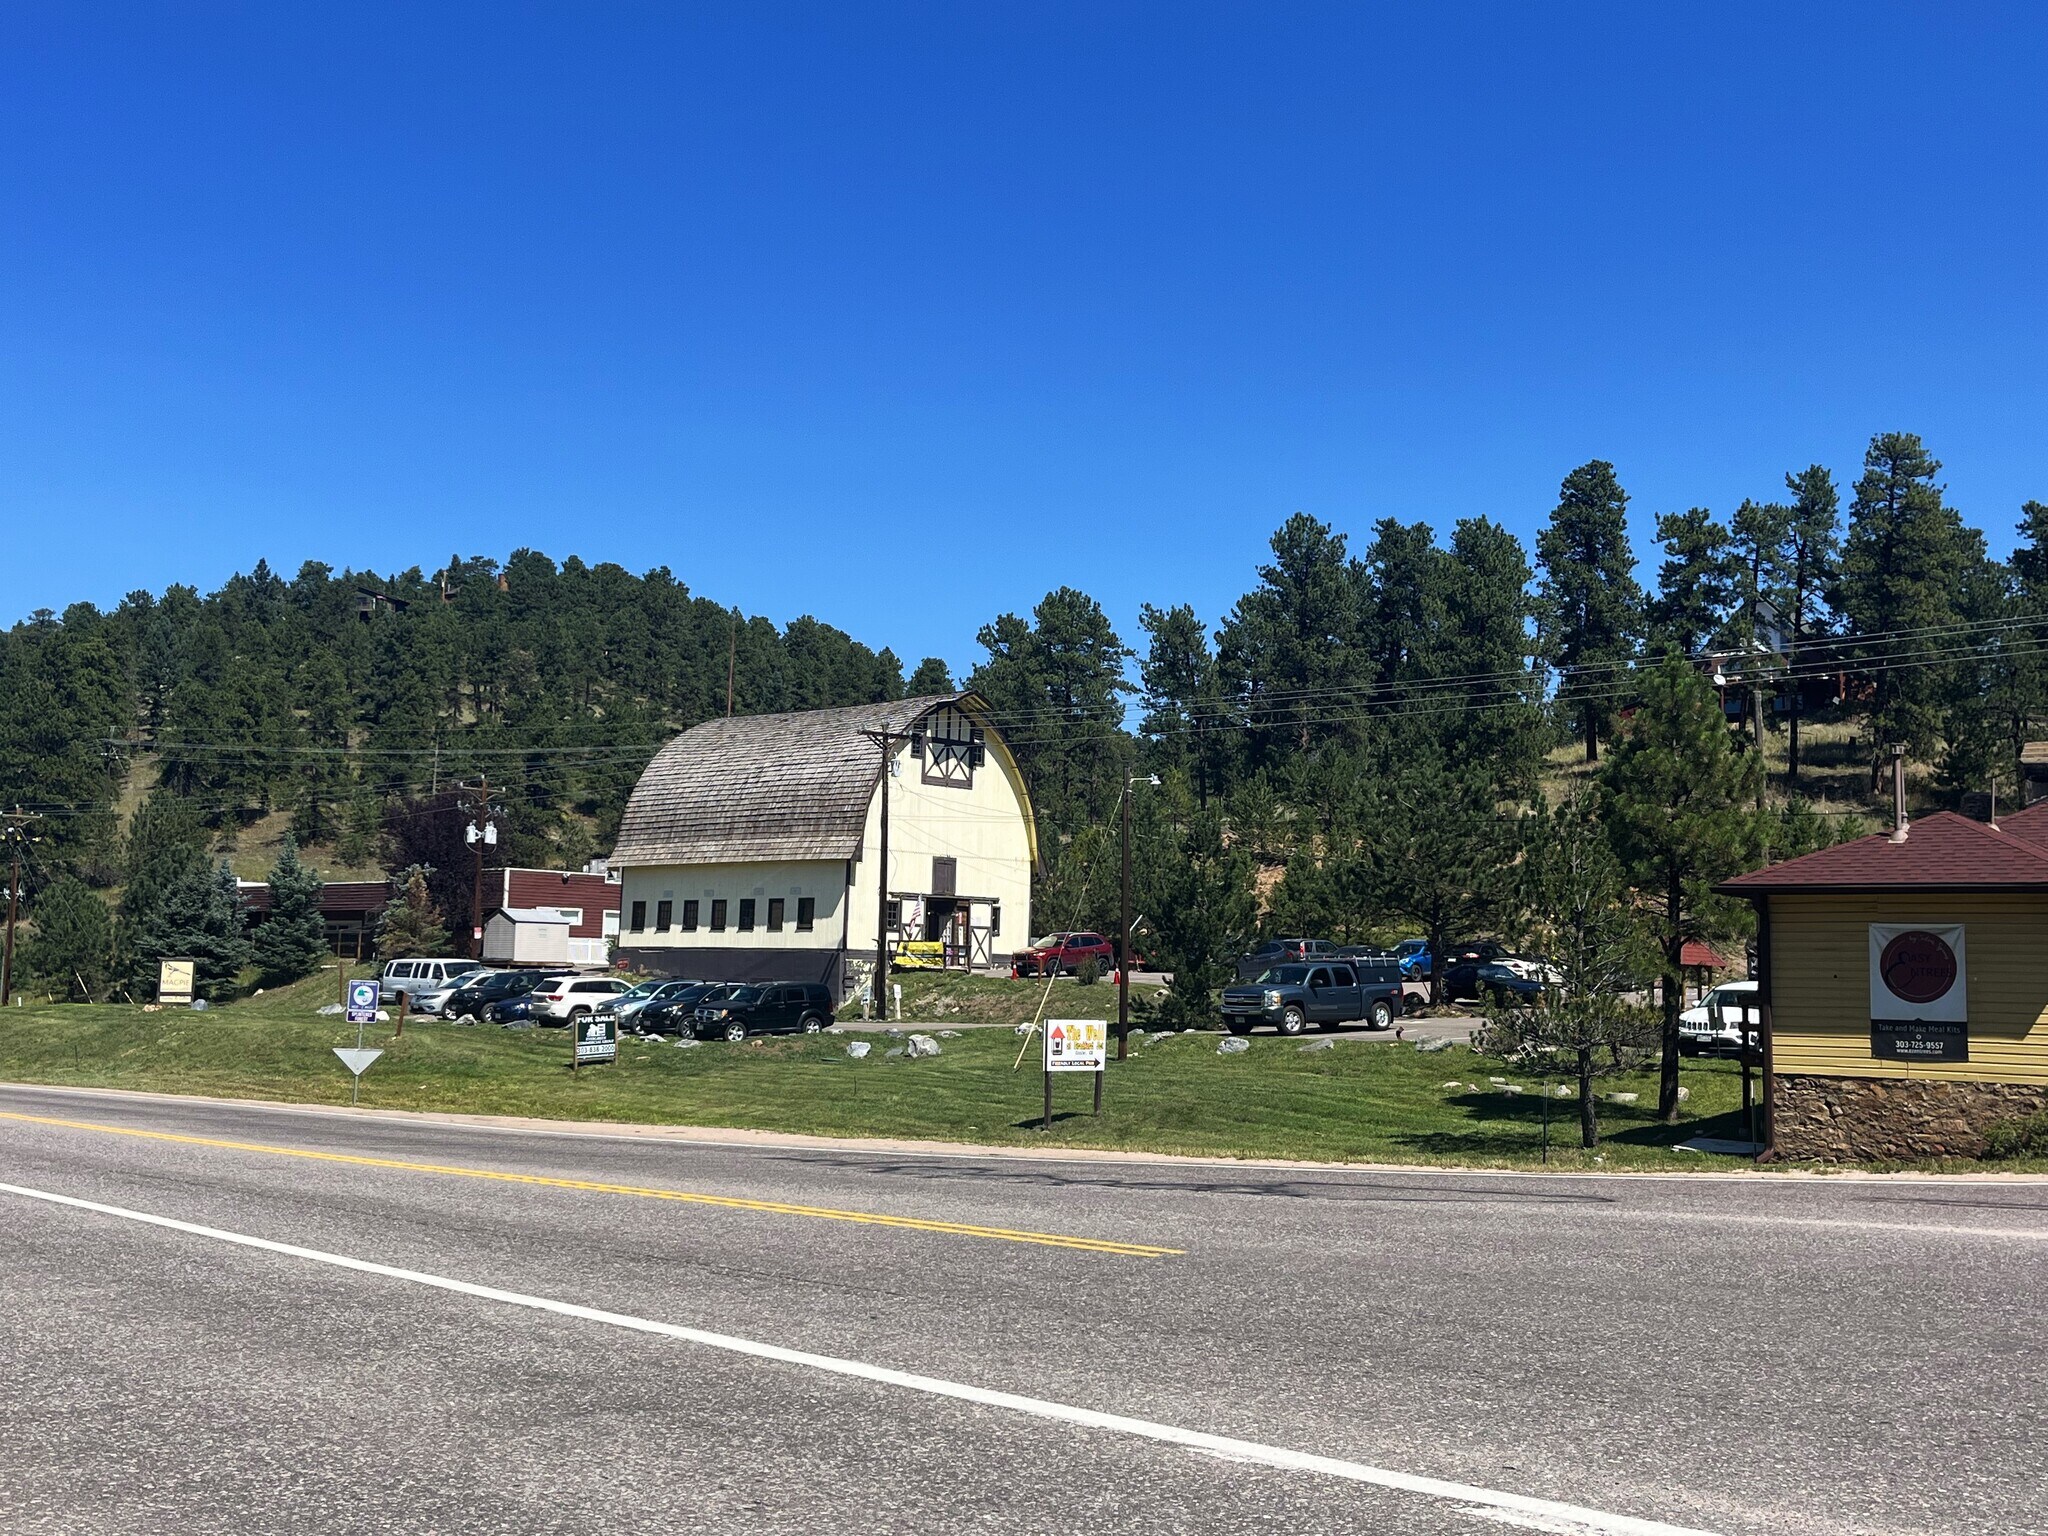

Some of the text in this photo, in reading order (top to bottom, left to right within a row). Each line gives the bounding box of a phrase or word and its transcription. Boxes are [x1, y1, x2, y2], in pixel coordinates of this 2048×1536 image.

[594, 1014, 616, 1023] SALE
[1066, 1024, 1081, 1041] The
[1878, 1023, 1961, 1034] Take and Make Meal Kits
[1895, 1040, 1944, 1050] 303-725-9557
